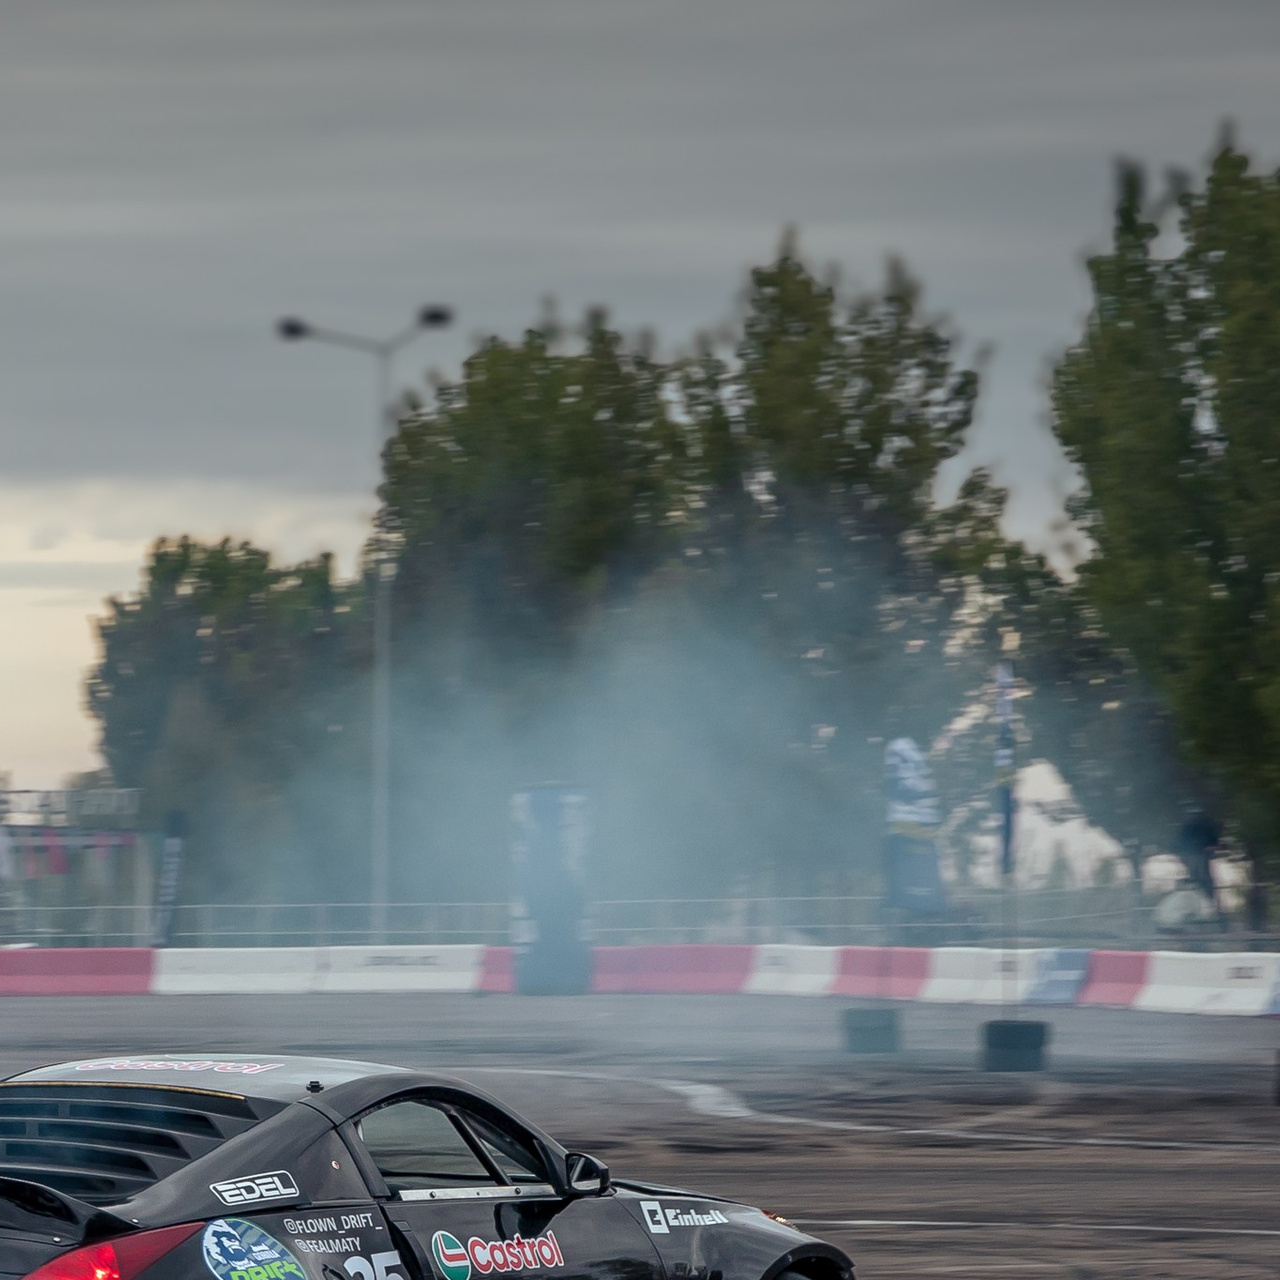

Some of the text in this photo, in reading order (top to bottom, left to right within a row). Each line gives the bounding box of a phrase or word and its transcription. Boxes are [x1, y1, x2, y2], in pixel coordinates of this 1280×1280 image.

[76, 1060, 285, 1075] Castrol
[214, 1176, 297, 1203] EDEL
[665, 1207, 730, 1227] Einhell
[468, 1230, 564, 1274] Castrol
